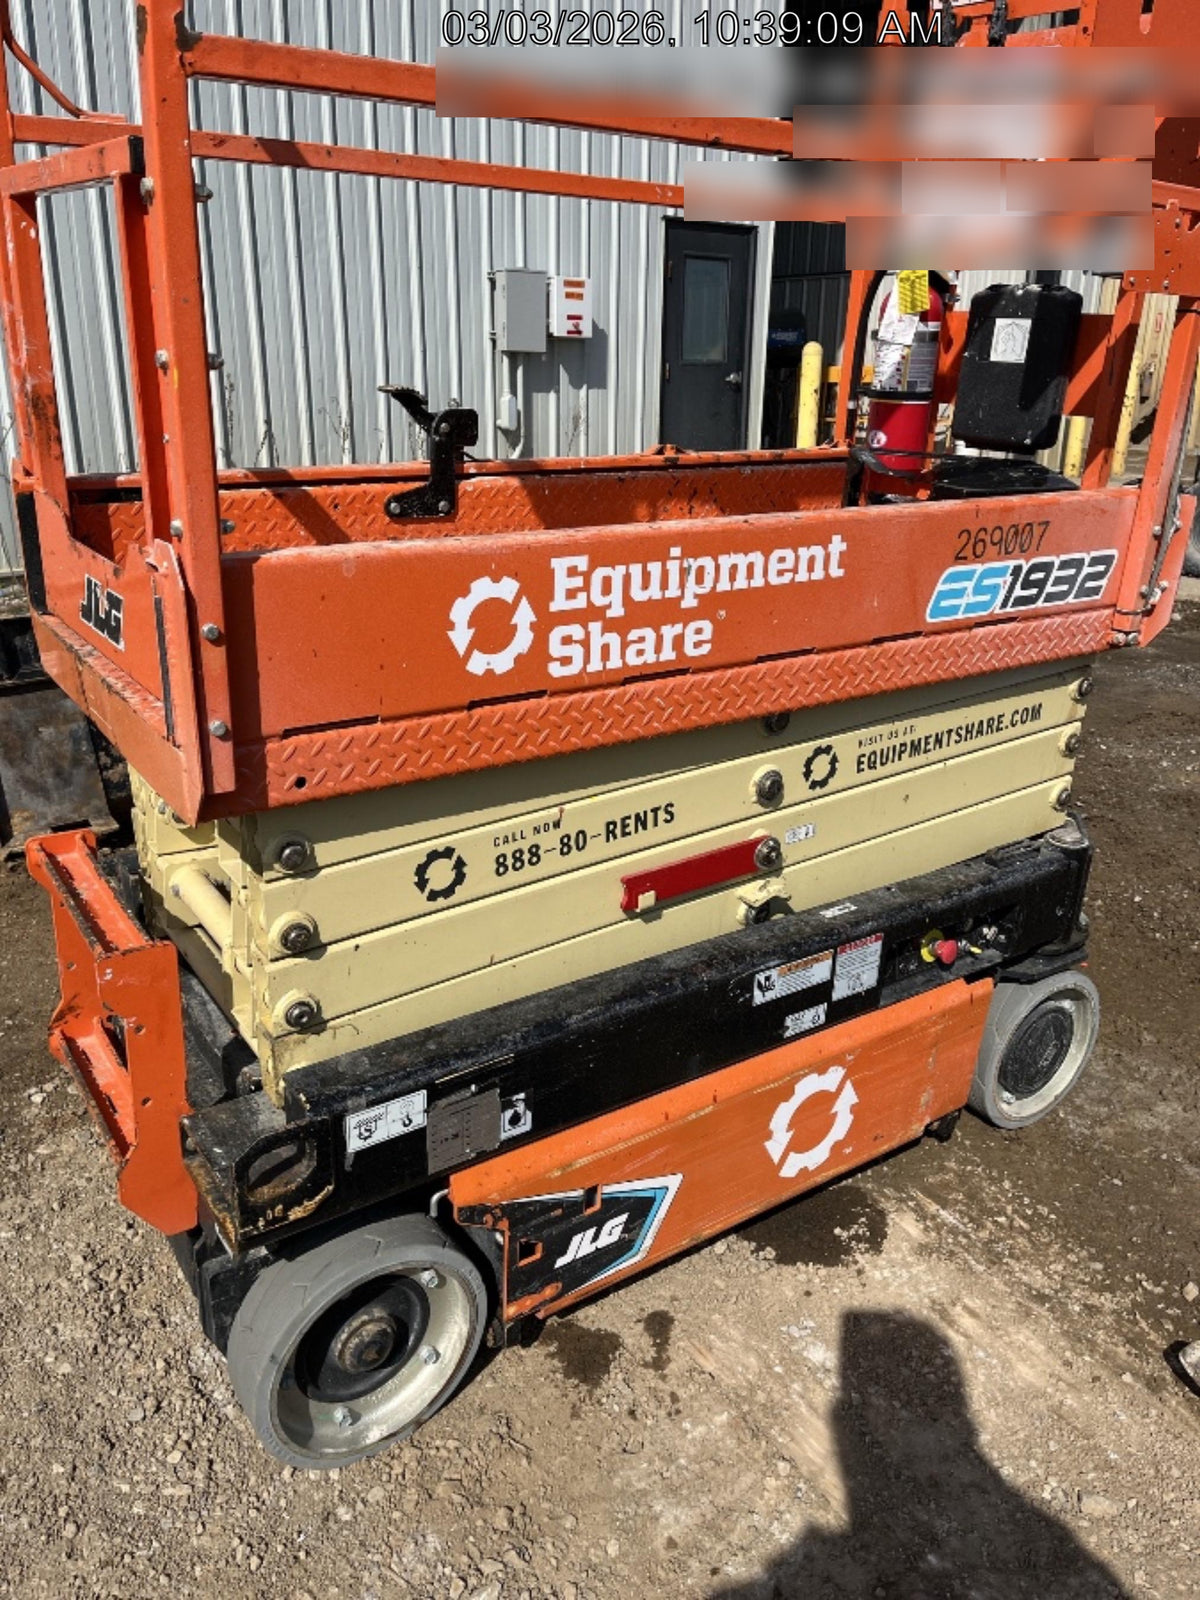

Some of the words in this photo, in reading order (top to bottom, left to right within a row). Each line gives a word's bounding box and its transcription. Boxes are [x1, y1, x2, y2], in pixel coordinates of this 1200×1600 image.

[549, 534, 847, 618] Equipment
[954, 521, 1050, 560] 269007
[80, 573, 125, 651] JLG
[926, 549, 1119, 622] ES1932
[547, 619, 713, 678] Share
[856, 703, 1043, 774] EQUIPMENTSHARE.COM
[493, 829, 527, 848] CALL
[533, 819, 562, 836] NOW
[495, 802, 675, 877] 888-80-RENTS
[554, 1212, 630, 1269] JLG
